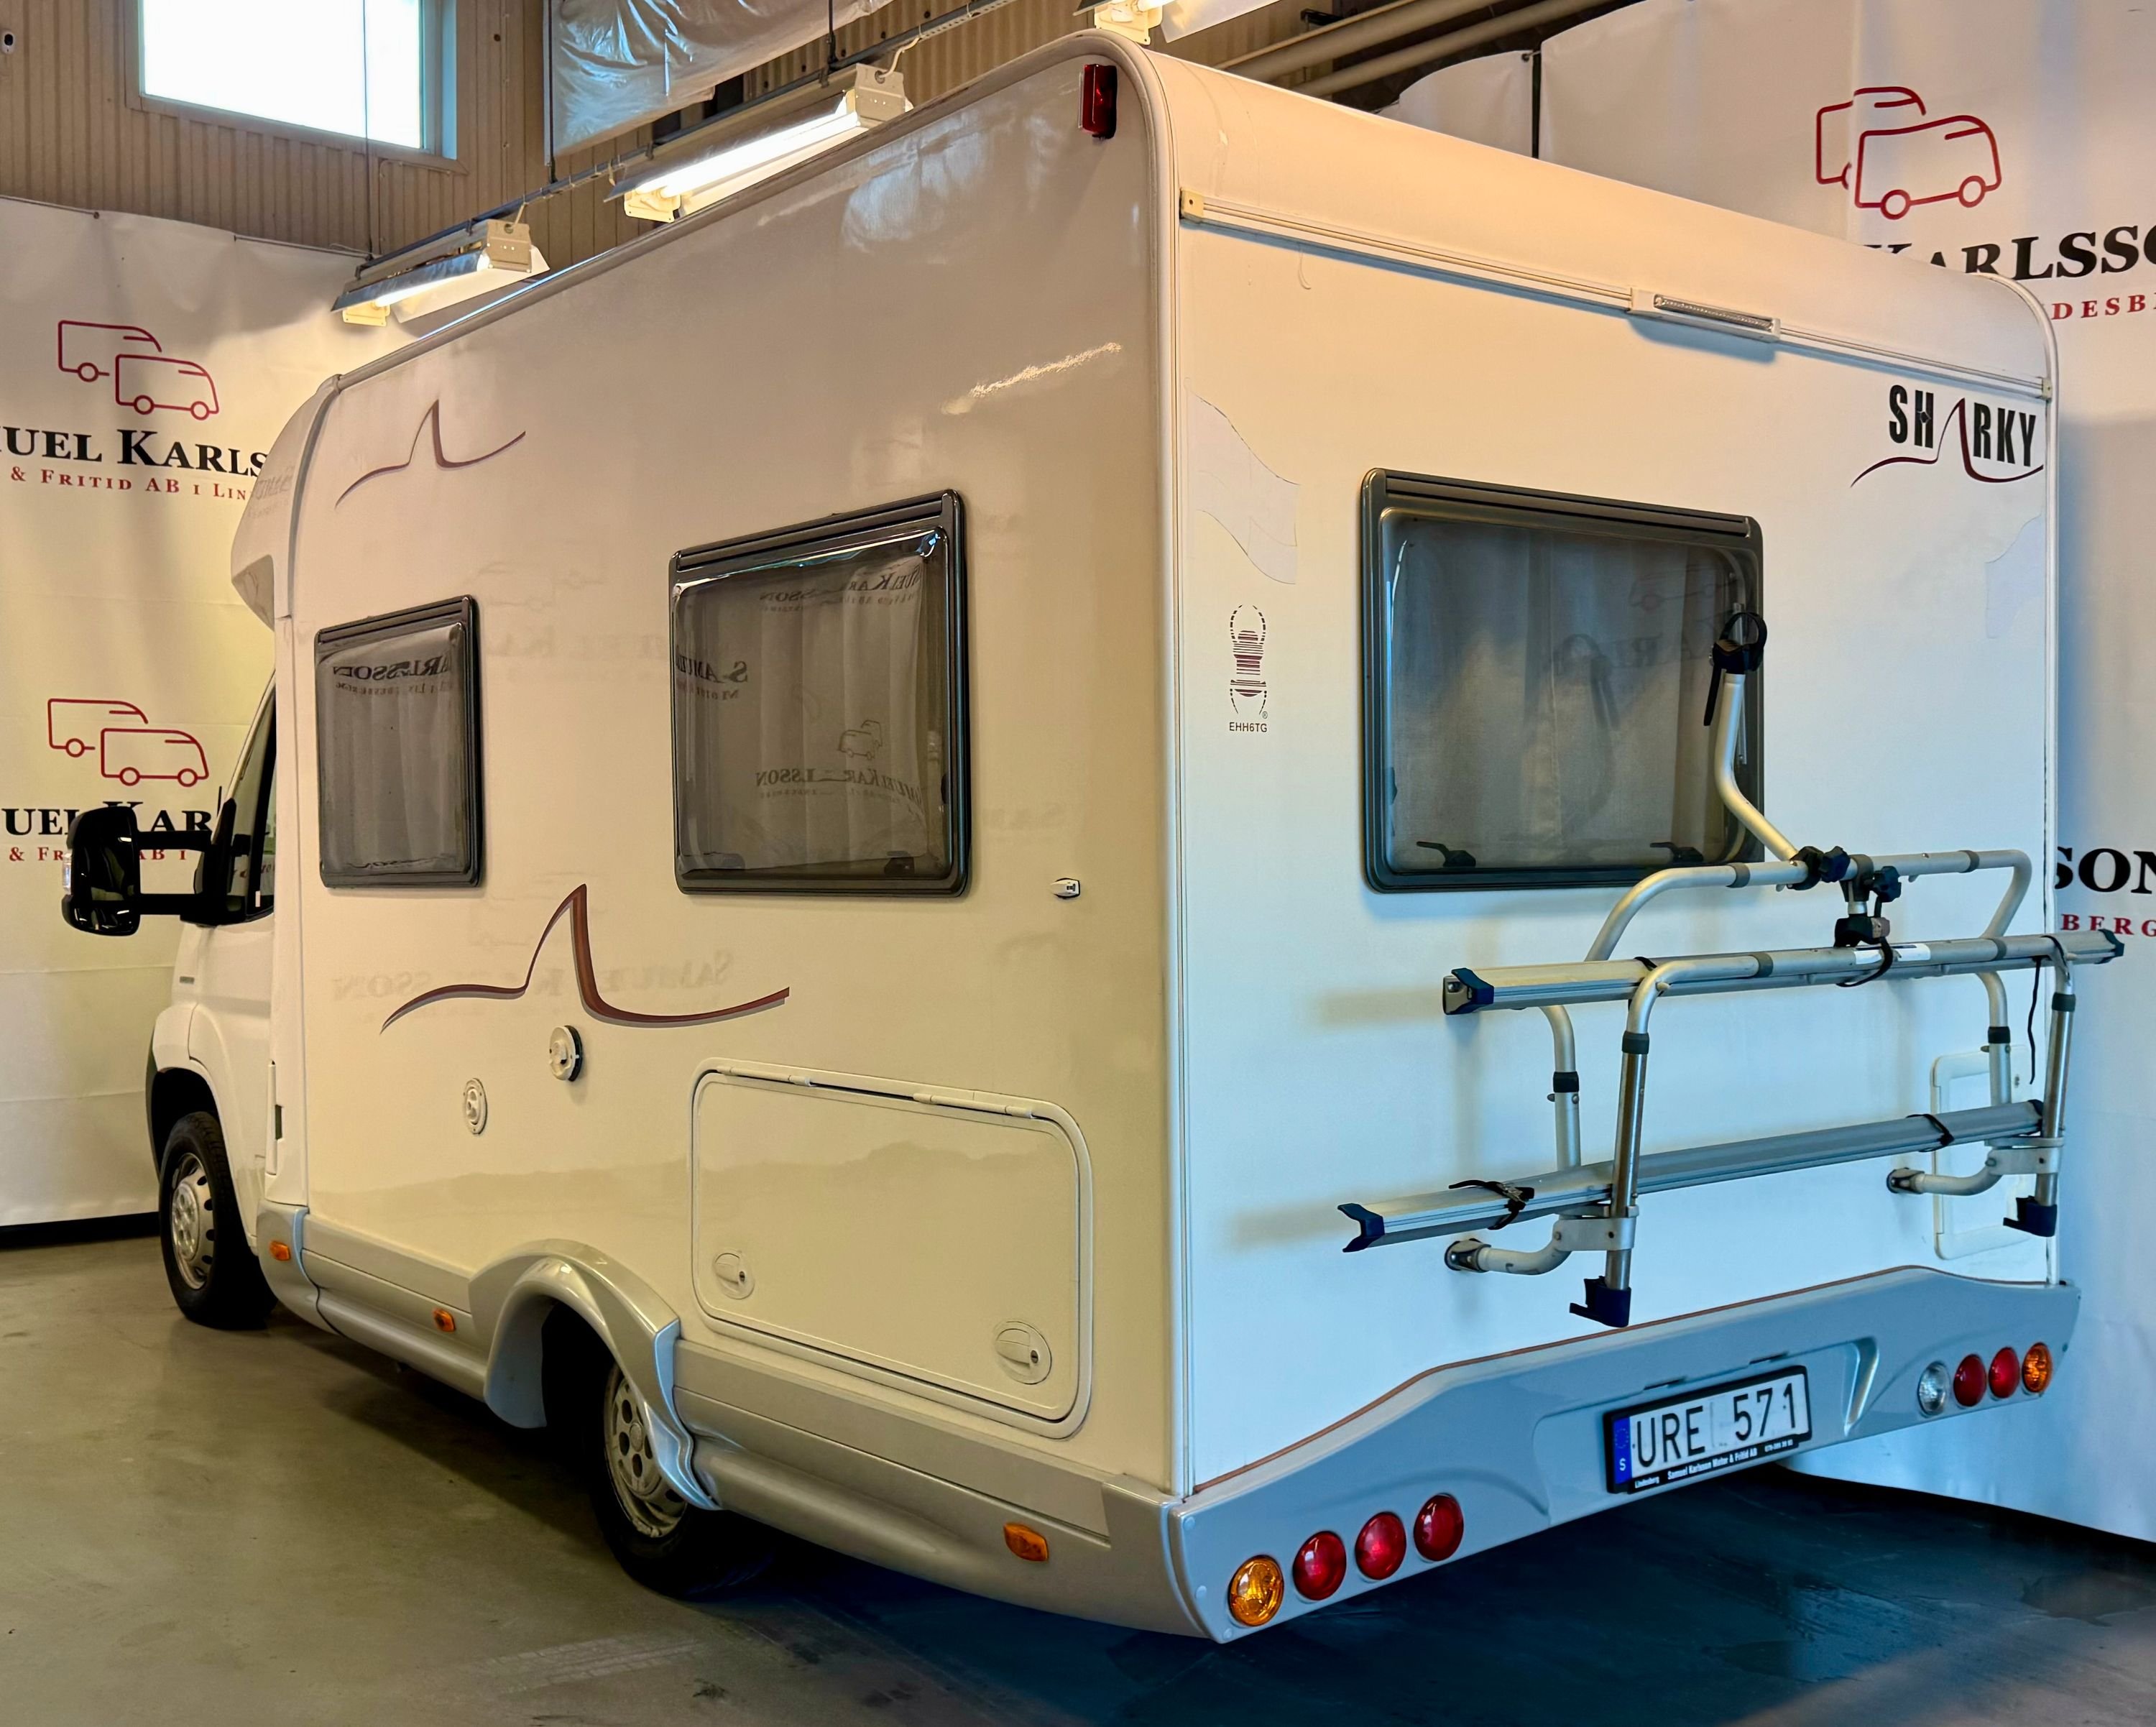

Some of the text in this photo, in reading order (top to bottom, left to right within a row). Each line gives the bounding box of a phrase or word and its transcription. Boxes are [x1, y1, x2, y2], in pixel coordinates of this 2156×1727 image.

[1864, 225, 2156, 281] RLSS
[2051, 292, 2156, 320] DESB
[0, 425, 102, 462] UEL
[11, 466, 26, 482] &
[145, 477, 180, 493] AB
[213, 483, 252, 500] LIN
[1229, 722, 1268, 733] EHH6TG
[9, 847, 24, 861] &
[1637, 1383, 1796, 1468] URE 571
[1619, 1458, 1626, 1471] S
